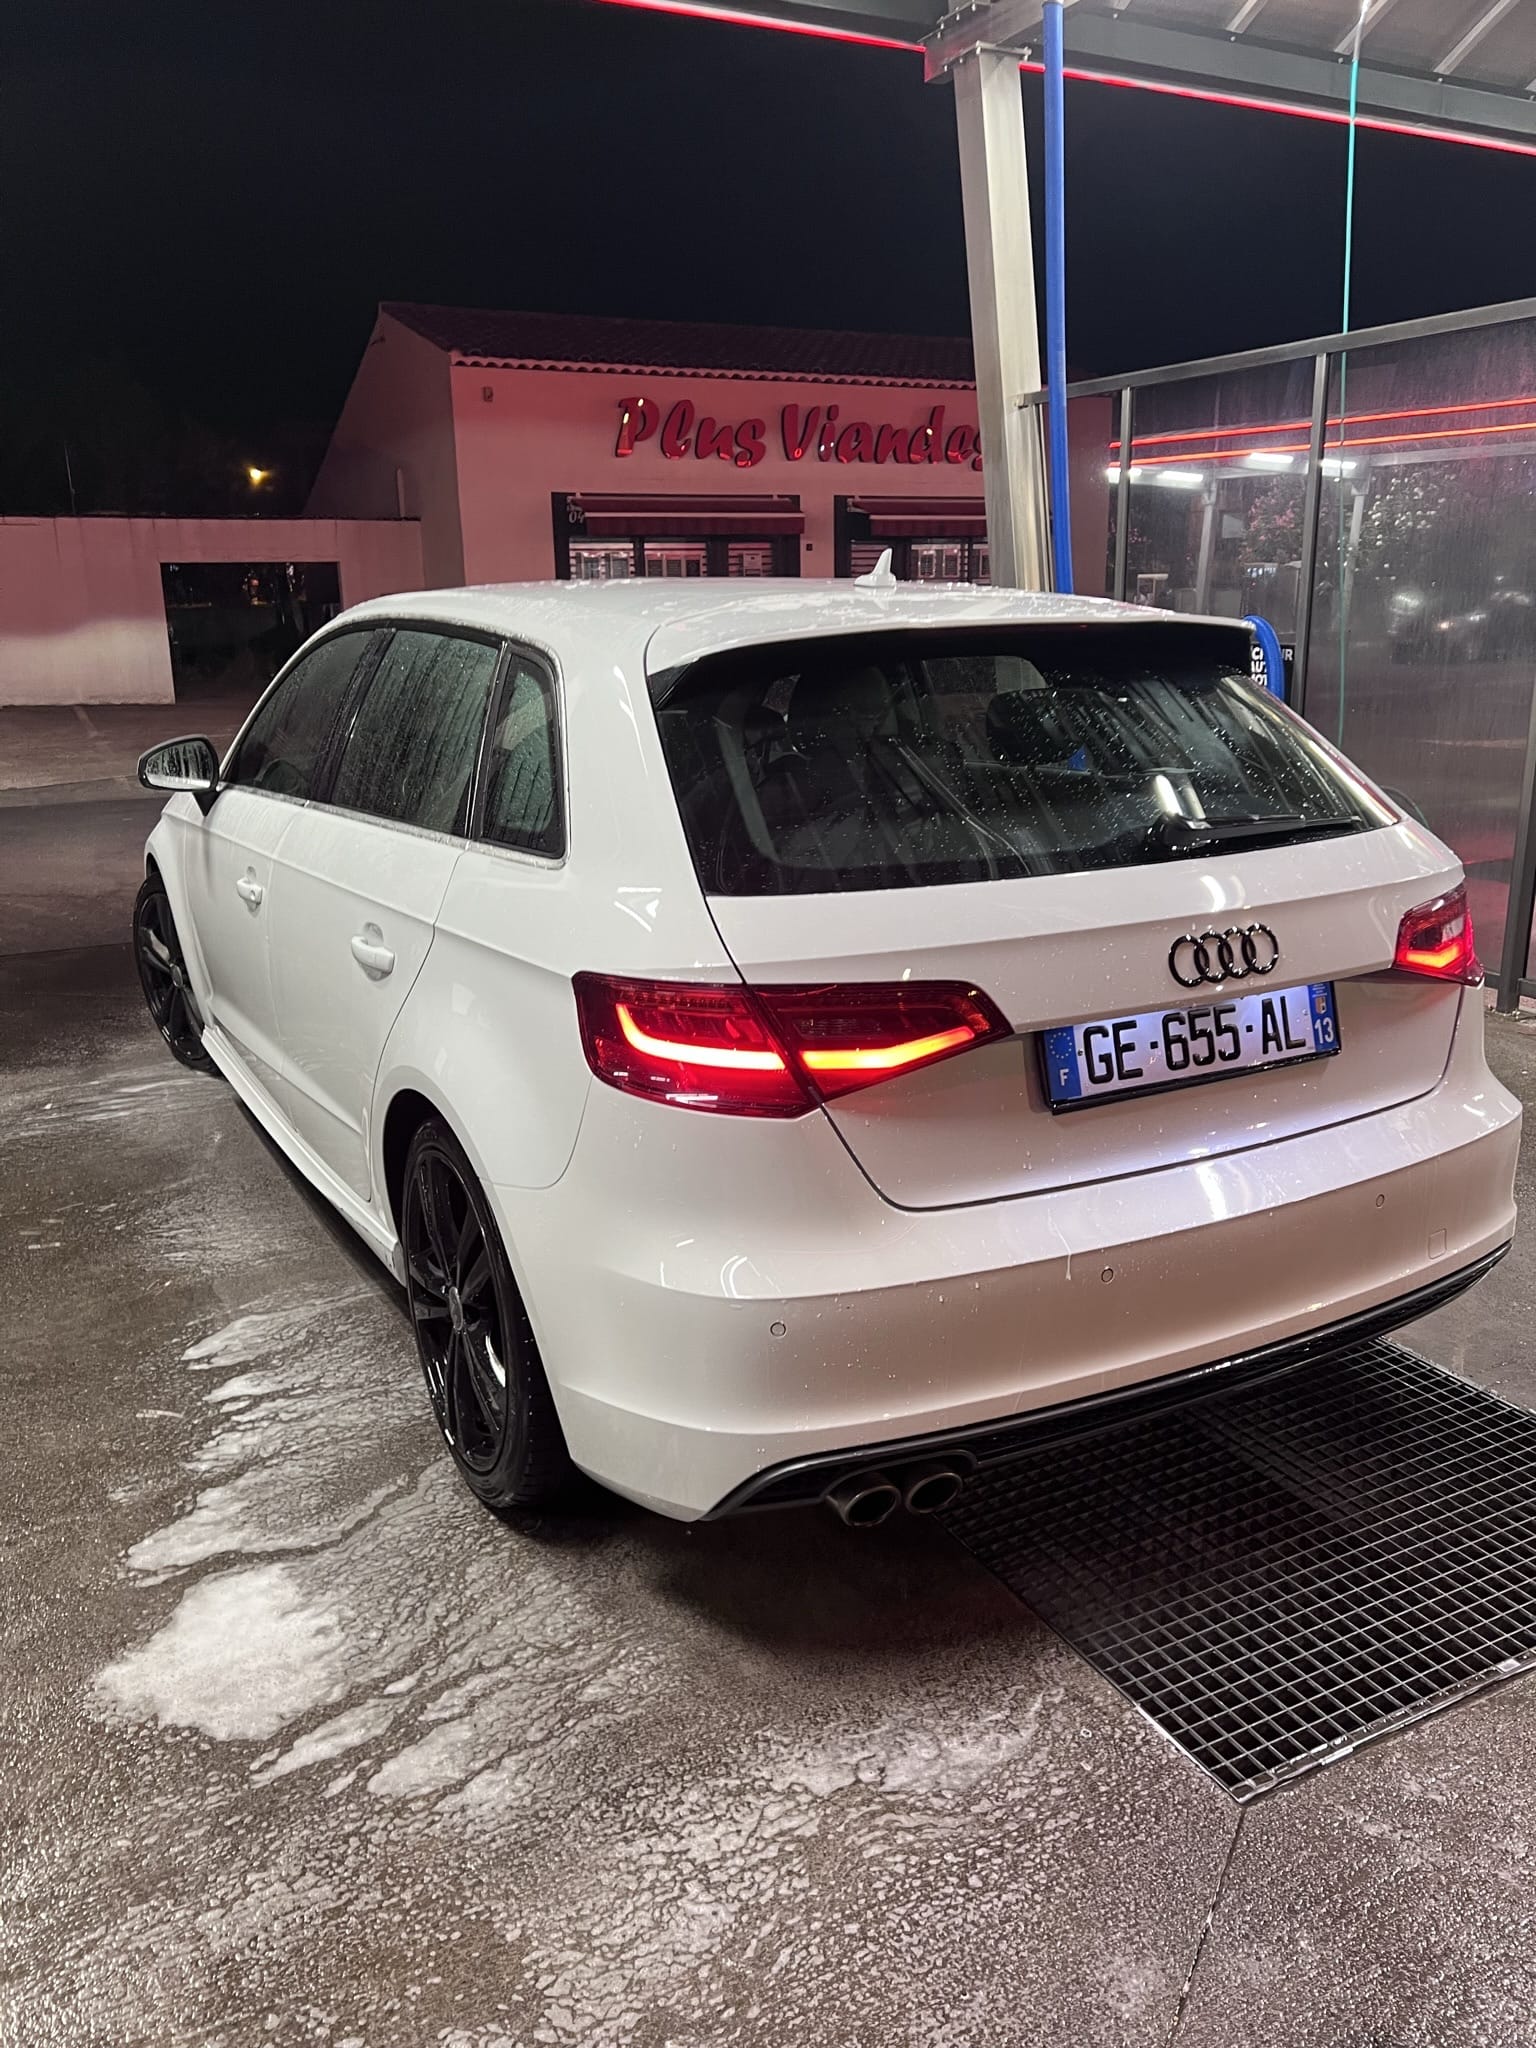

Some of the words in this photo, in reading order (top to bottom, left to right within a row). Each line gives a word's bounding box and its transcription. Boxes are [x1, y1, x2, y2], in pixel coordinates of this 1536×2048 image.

[615, 397, 767, 467] Plus
[1314, 1017, 1335, 1044] 13
[1059, 1069, 1069, 1087] F
